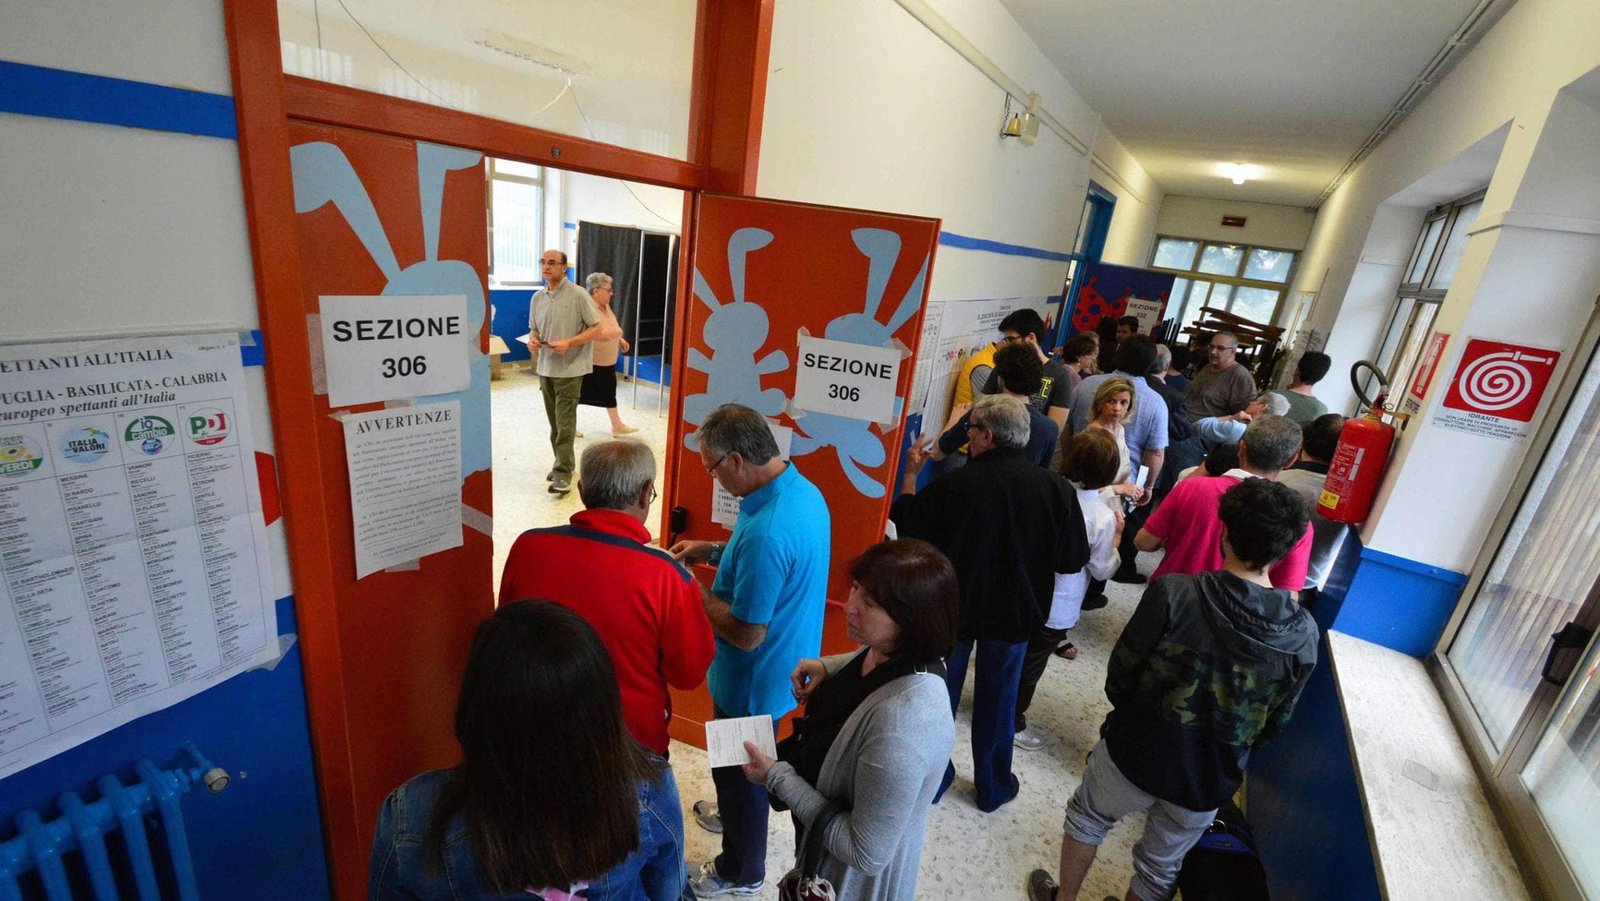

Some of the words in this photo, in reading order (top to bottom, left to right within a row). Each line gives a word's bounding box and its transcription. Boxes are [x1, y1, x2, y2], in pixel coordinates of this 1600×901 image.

[333, 316, 460, 342] SEZIONE
[84, 350, 173, 366] ALL'ITALIA
[382, 356, 426, 378] 306
[804, 353, 892, 380] SEZIONE
[67, 380, 150, 398] BASILICATA
[162, 372, 227, 388] CALABRIA
[828, 384, 860, 402] 306
[60, 398, 118, 416] spettanti
[122, 392, 176, 406] all'Italia
[190, 412, 226, 434] PD
[356, 410, 452, 434] AVVERTENZE
[1468, 413, 1500, 423] IDRANTE
[68, 438, 98, 448] ITALIA
[72, 443, 106, 453] VALORI
